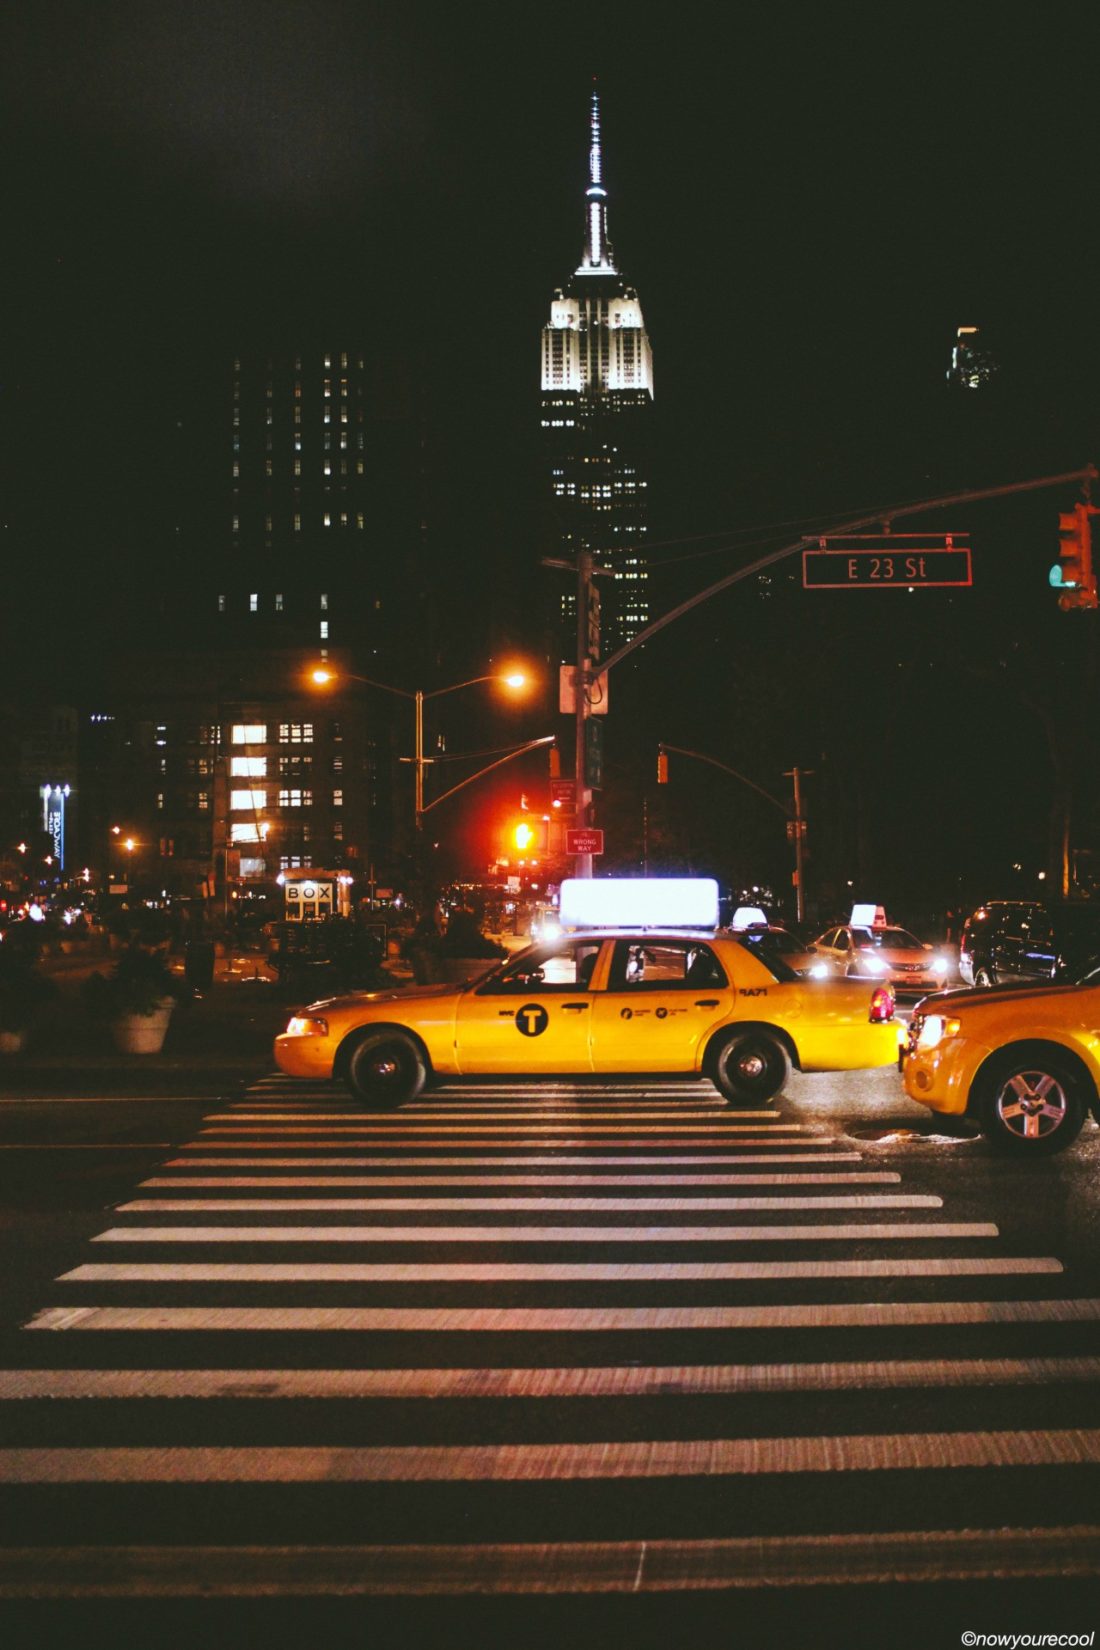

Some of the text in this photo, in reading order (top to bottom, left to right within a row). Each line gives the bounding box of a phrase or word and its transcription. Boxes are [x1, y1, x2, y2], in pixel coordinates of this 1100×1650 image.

[848, 557, 927, 579] E 23 St
[288, 887, 330, 899] BOX
